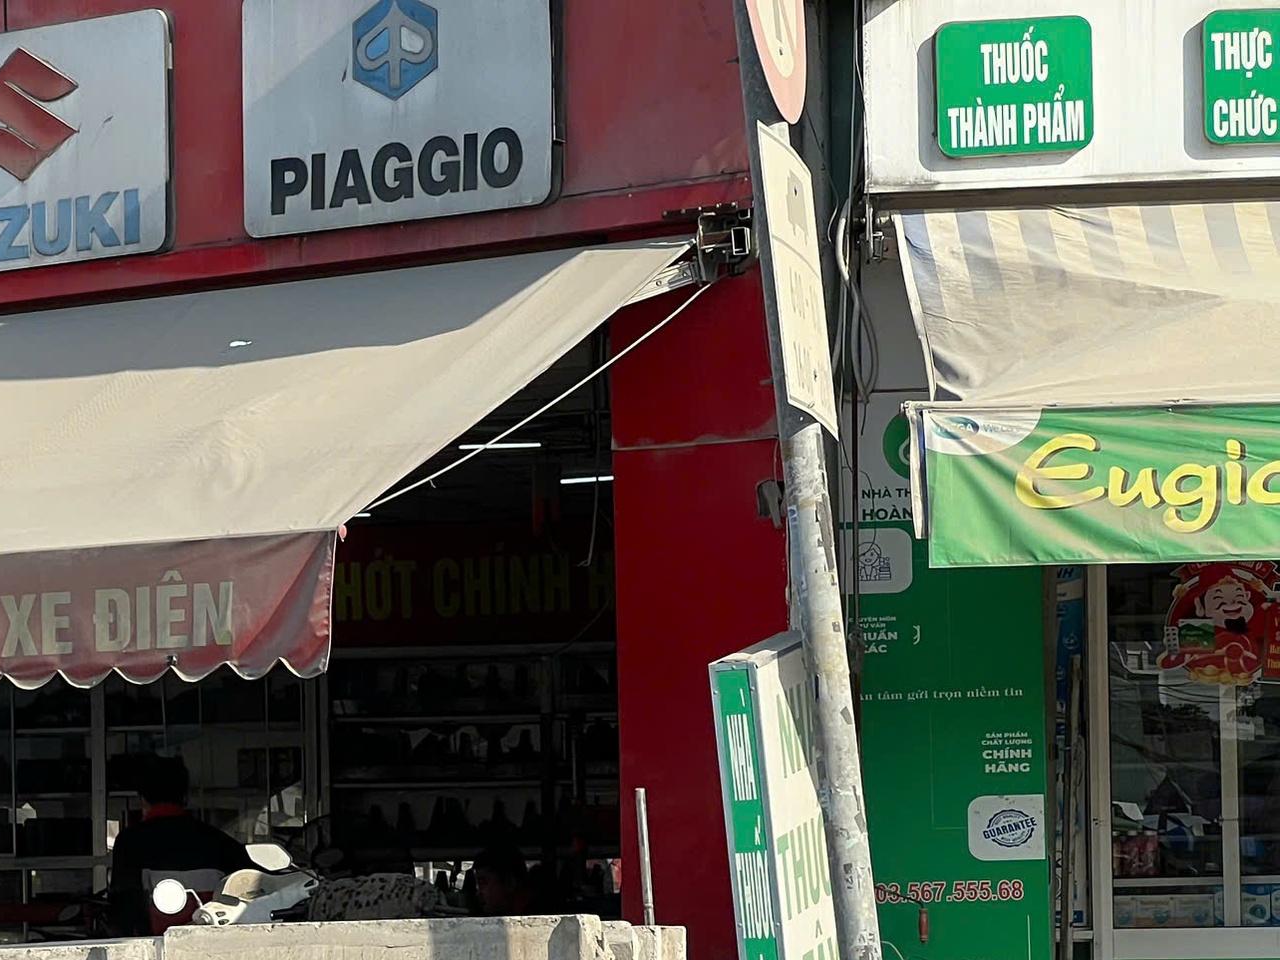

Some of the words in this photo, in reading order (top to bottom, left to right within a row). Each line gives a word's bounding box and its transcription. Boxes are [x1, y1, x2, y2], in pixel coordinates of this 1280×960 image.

[980, 26, 1049, 85] THUỐC
[1211, 27, 1272, 78] THỰC
[947, 97, 1018, 149] THÀNH
[1023, 83, 1085, 145] PHẨM
[1213, 90, 1277, 138] CHỨC
[270, 127, 522, 216] PIAGGIO
[862, 486, 892, 499] NHÀ
[1, 592, 73, 657] XE
[982, 747, 1032, 759] CHÍNH
[985, 761, 1030, 773] HÃNG
[983, 817, 1037, 839] GUARANTEE
